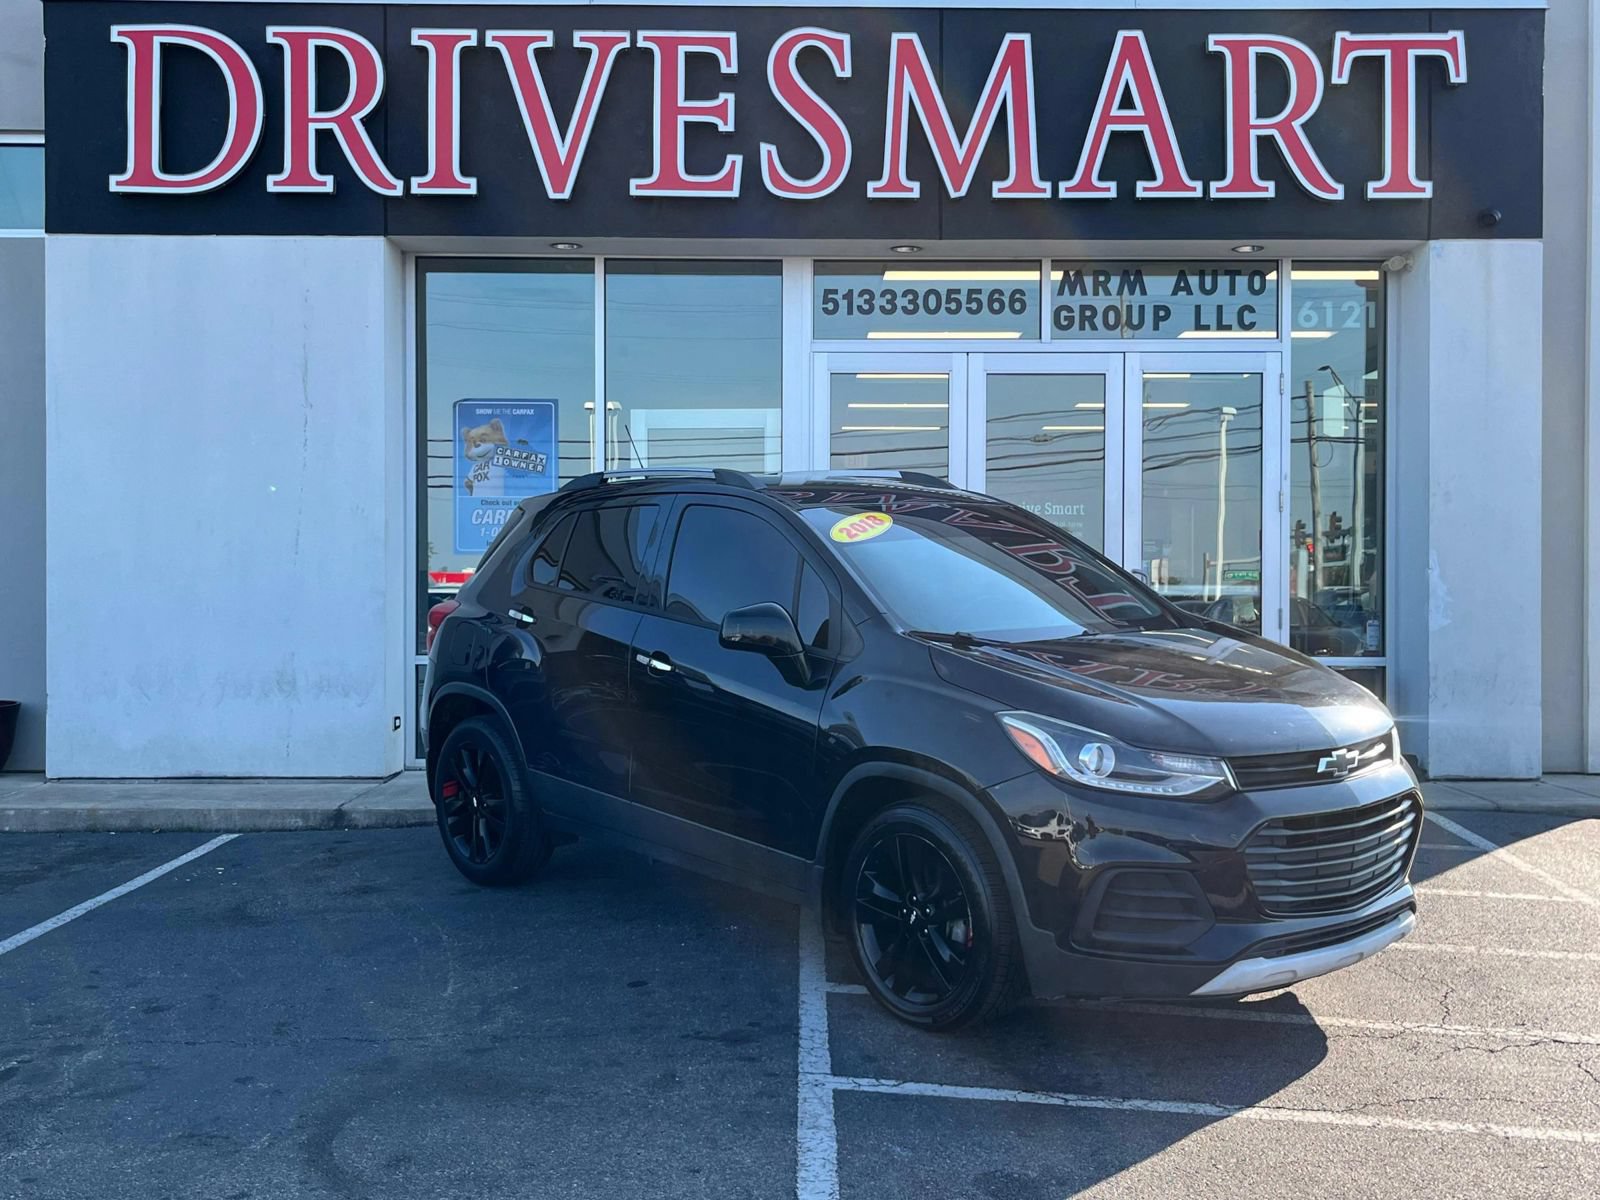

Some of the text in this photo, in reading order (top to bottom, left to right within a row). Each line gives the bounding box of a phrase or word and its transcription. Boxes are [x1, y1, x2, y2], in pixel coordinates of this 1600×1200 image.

[109, 24, 1469, 201] DRIVESMART
[1056, 269, 1267, 297] MRM AUTO
[821, 288, 1027, 316] 5133305566
[1053, 304, 1257, 331] GROUP LLC
[1297, 301, 1376, 329] 6121
[474, 461, 490, 472] CAR
[496, 447, 546, 464] CARFAX
[473, 471, 490, 482] FOX
[1044, 502, 1085, 516] Smart
[838, 515, 885, 539] 2018
